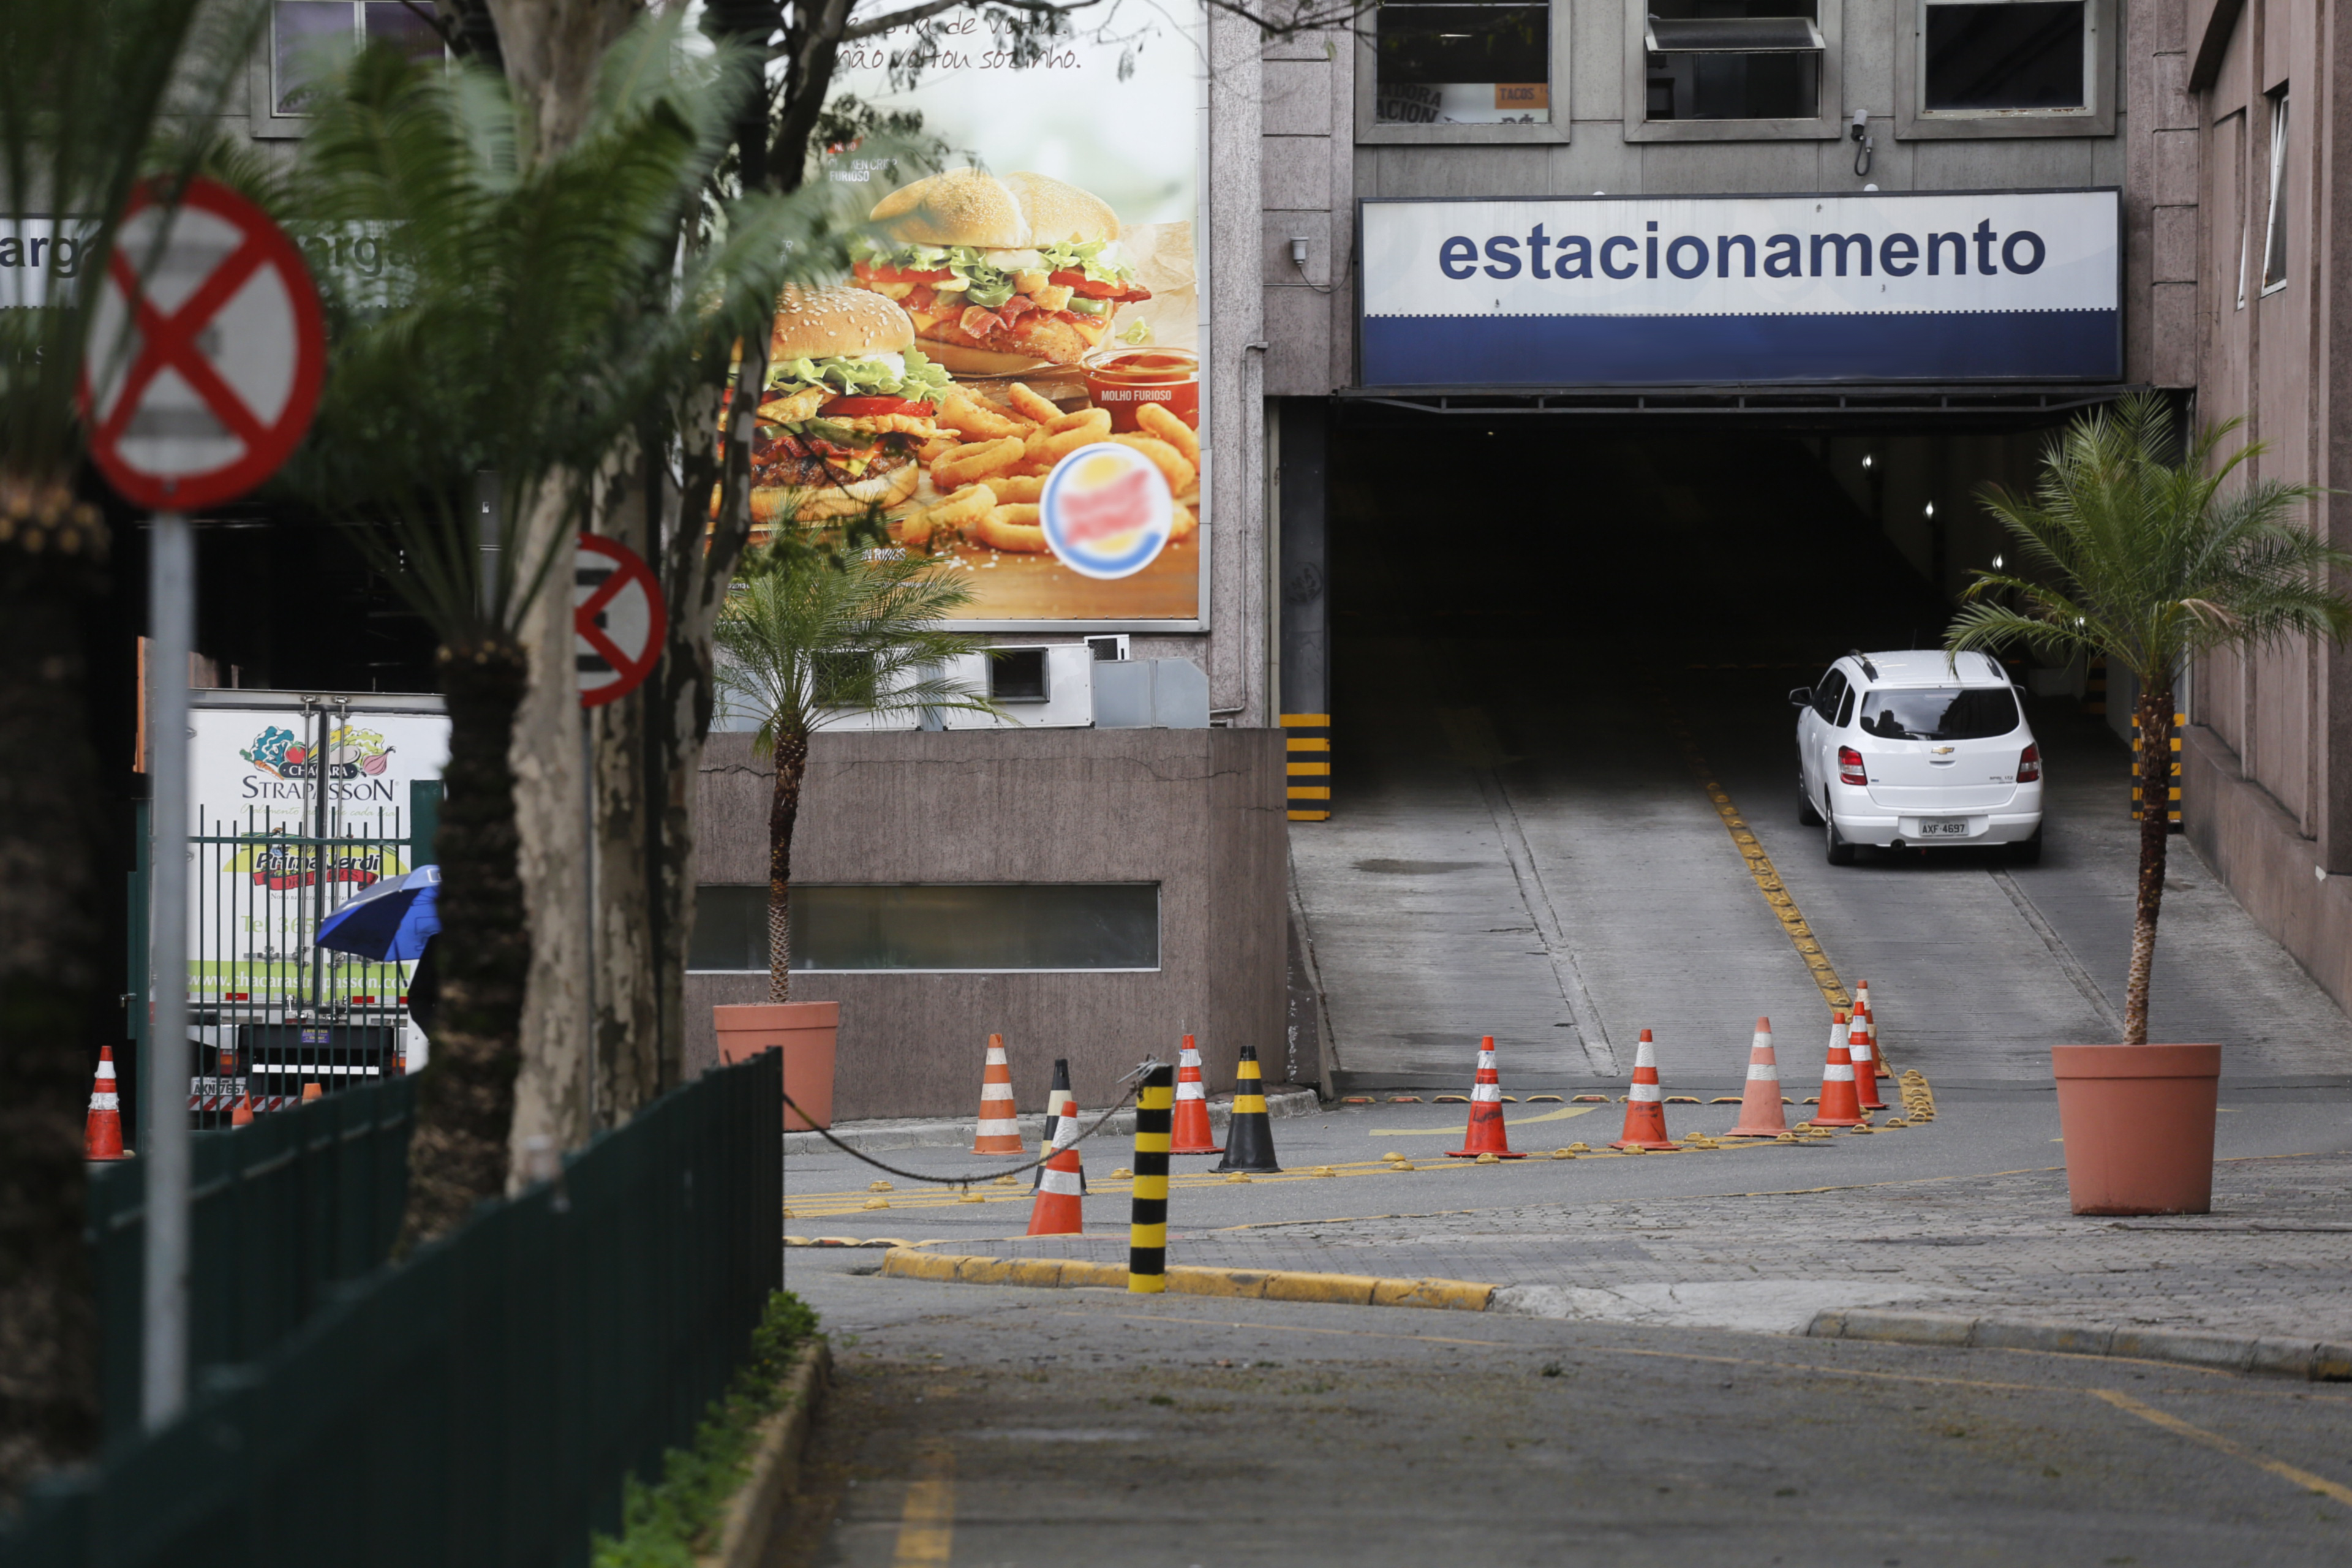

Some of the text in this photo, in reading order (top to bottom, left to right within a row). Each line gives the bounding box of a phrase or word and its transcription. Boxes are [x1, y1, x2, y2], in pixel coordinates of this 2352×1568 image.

[944, 11, 978, 34] de
[891, 44, 973, 69] voltou
[979, 43, 1081, 69] sozinho.
[1500, 88, 1534, 100] TACOS
[829, 159, 868, 170] CKEN
[829, 171, 870, 182] FURIOSO
[1439, 219, 2046, 279] estacionamento
[1101, 390, 1172, 401] MOLHO FURIOSO
[289, 764, 348, 777] CHÁRA
[242, 775, 394, 802] STRAPSSON
[241, 915, 270, 933] Tel
